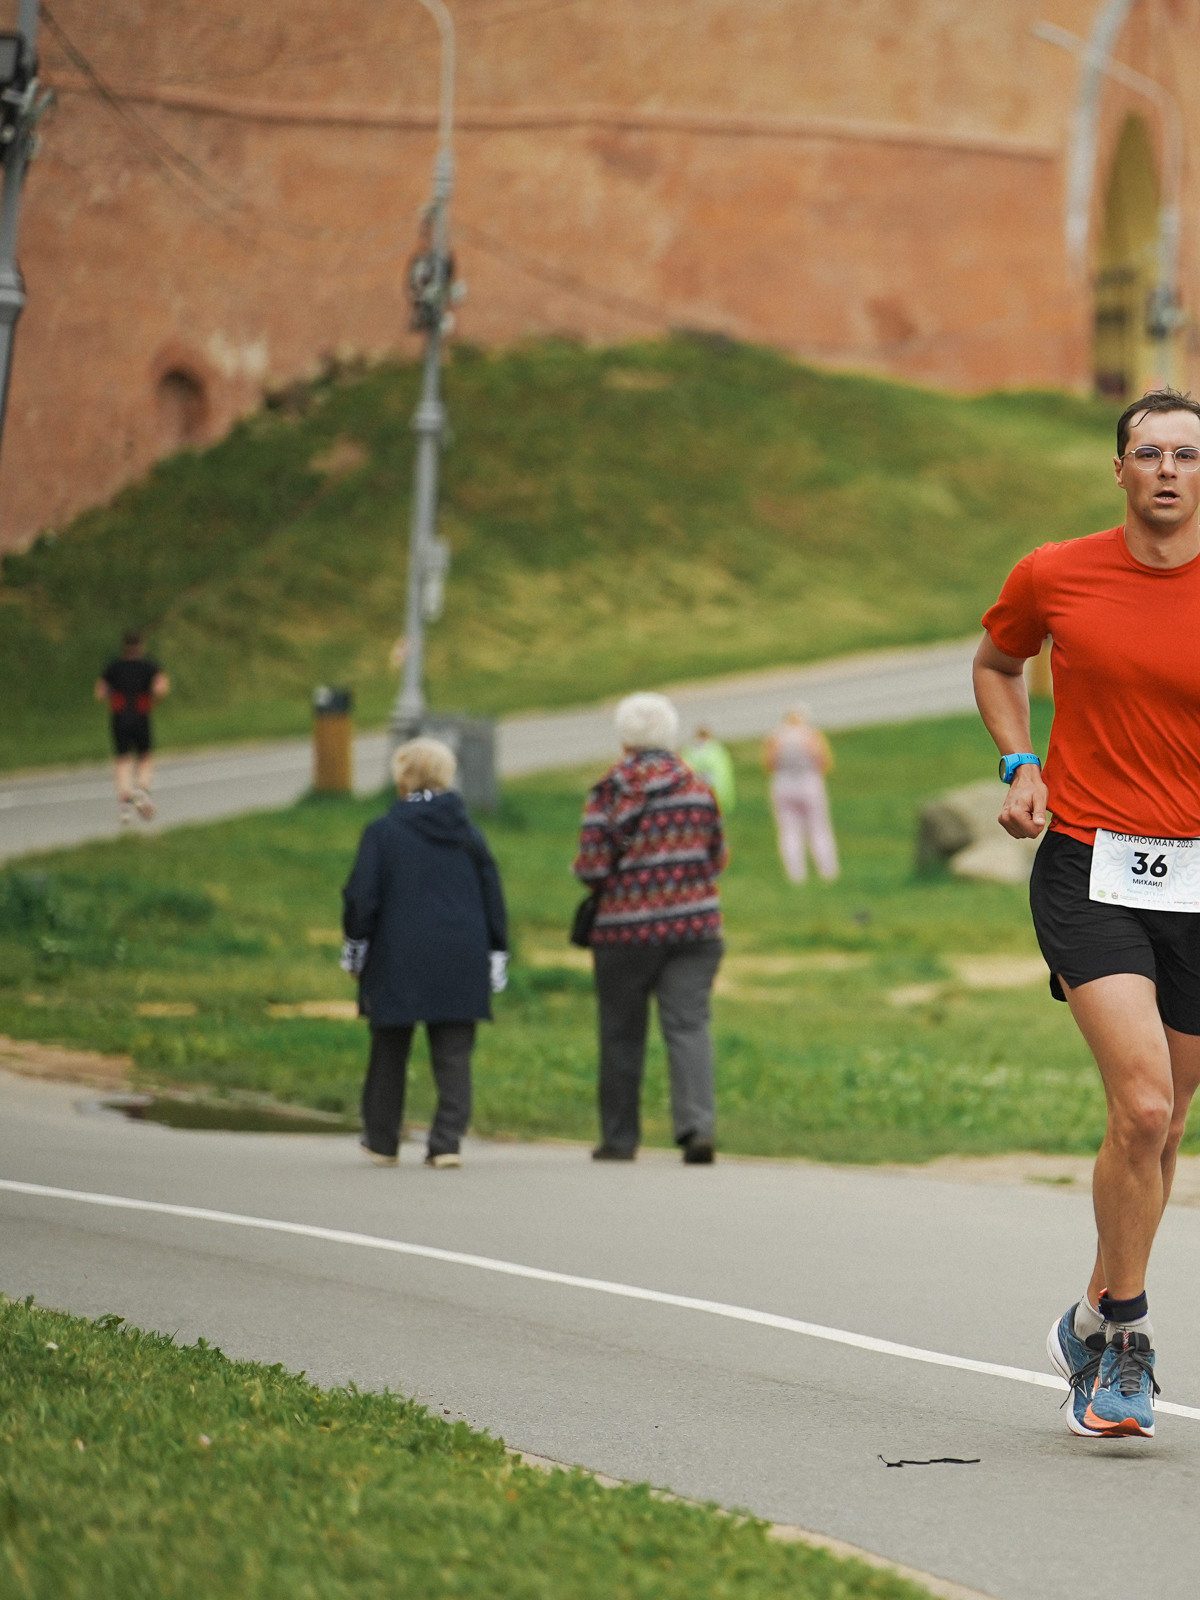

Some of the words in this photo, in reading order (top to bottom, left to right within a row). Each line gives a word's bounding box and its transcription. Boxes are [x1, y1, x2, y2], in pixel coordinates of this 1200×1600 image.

[1111, 832, 1174, 848] VOLKHOVMAN
[1177, 840, 1194, 848] 2023
[1131, 852, 1168, 878] 36
[1132, 878, 1163, 887] МИХАИЛ
